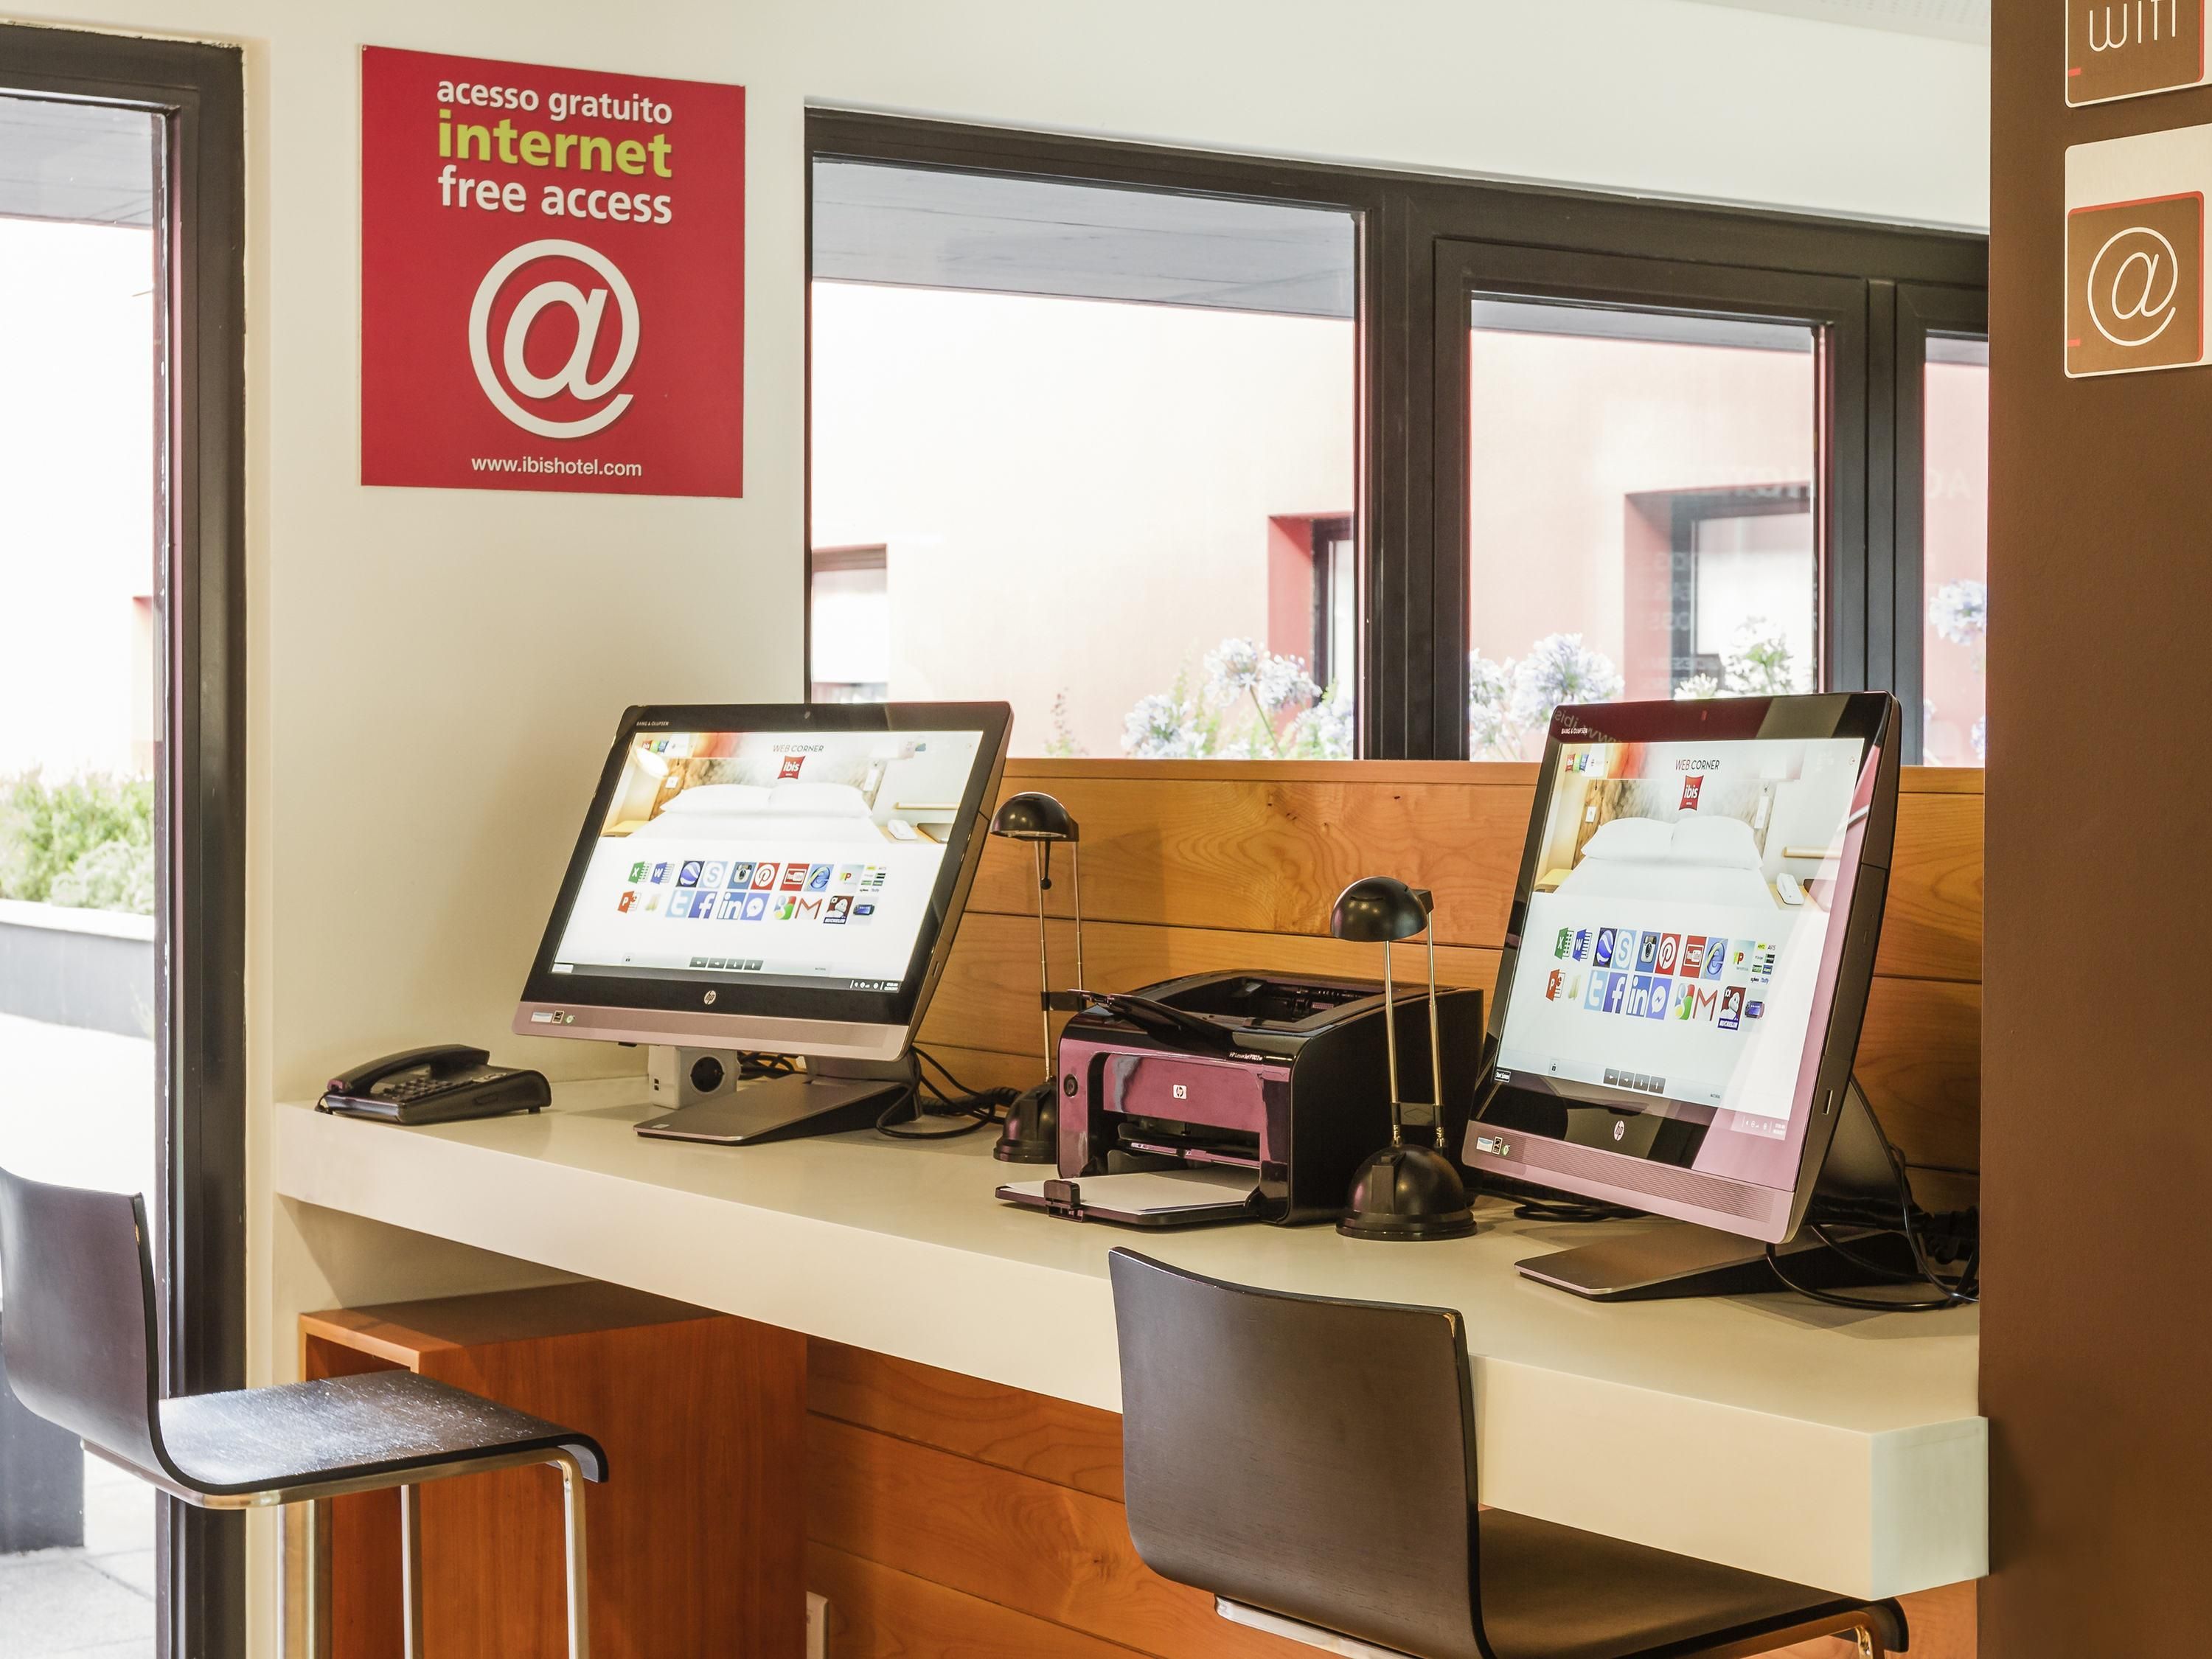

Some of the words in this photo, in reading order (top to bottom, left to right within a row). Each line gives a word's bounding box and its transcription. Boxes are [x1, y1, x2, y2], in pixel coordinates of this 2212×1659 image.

[437, 80, 539, 111] acesso
[548, 94, 672, 124] gratuito
[439, 109, 672, 178] internet
[438, 165, 526, 212] free
[541, 185, 672, 224] access
[470, 456, 642, 477] www.ibishotel.com
[782, 760, 800, 773] ibis
[1675, 760, 1690, 771] WEB
[1691, 759, 1720, 771] CORNER
[1684, 785, 1698, 799] ibis
